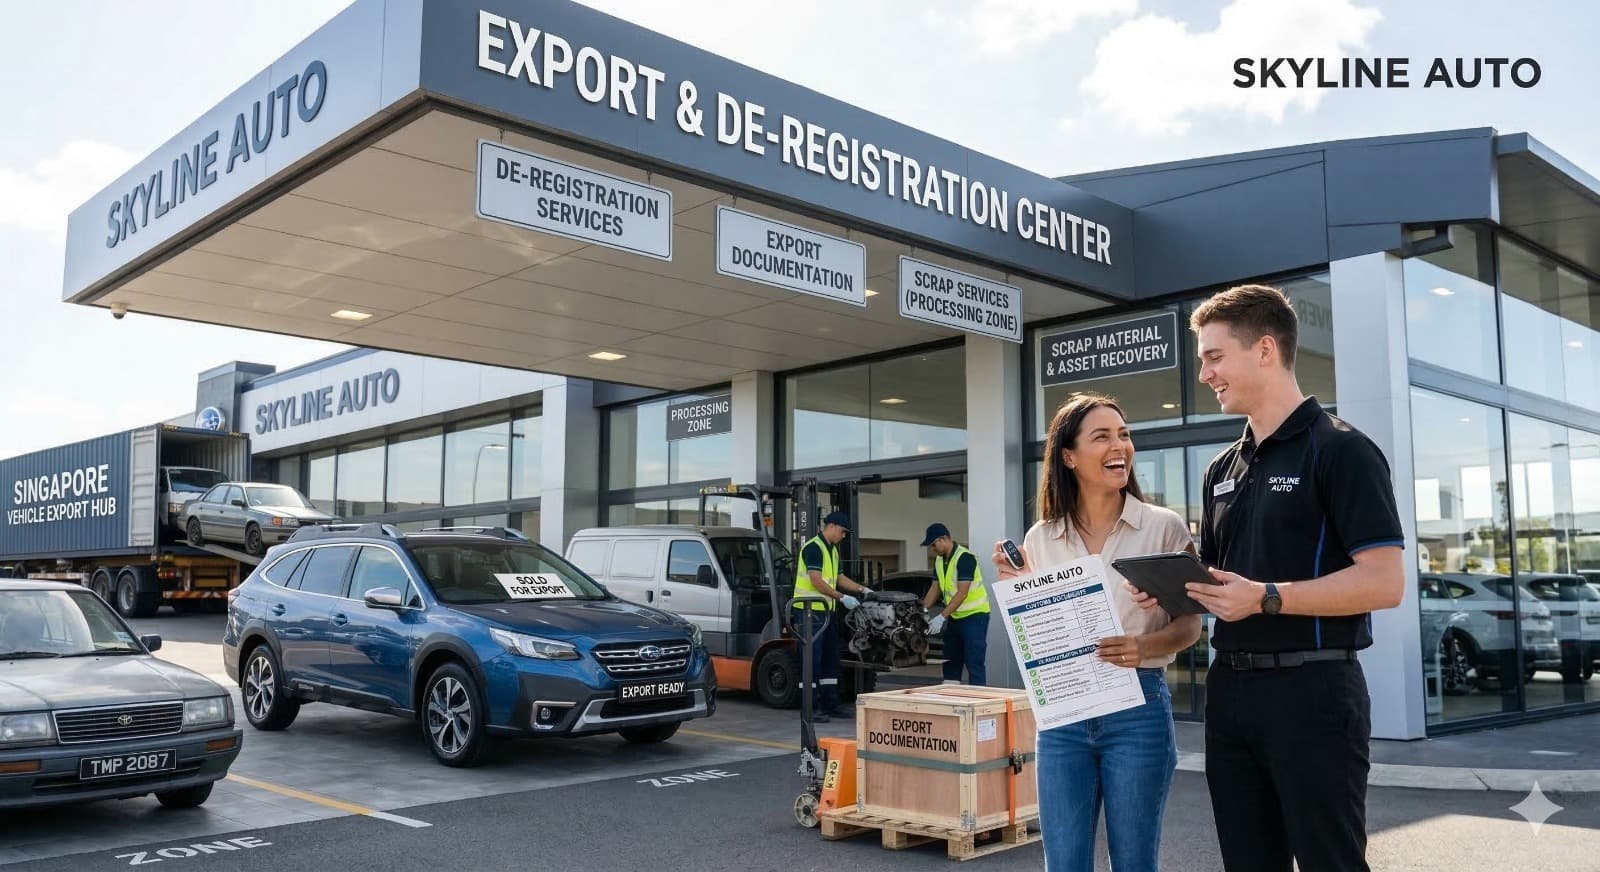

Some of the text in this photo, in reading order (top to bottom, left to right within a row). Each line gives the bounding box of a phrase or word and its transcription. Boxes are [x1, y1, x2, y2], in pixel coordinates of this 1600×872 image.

[478, 9, 1112, 265] EXPORT & DE-REGISTRATION CENTER
[106, 60, 327, 248] SKYLINE AUTO
[496, 158, 659, 219] DE-REGISTRATION
[537, 197, 624, 236] SERVICES
[767, 230, 822, 260] EXPORT
[732, 246, 853, 292] DOCUMENTATION
[915, 271, 1009, 309] SCRAP SERVICES
[906, 289, 1018, 335] (PROCESSING ZONE)
[1051, 326, 1162, 357] SCRAP MATERIAL
[1046, 343, 1169, 376] & ASSET RECOVERY
[255, 368, 400, 435] SKYLINE AUTO
[671, 401, 729, 421] PROCESSING
[687, 418, 712, 432] ZONE
[14, 464, 109, 505] SINGAPORE
[1268, 477, 1300, 485] SKYLINE
[7, 497, 116, 525] VEHICLE EXPORT HUB
[510, 585, 567, 595] FOR EXPORT
[516, 576, 548, 585] SOLD
[1014, 575, 1054, 592] SKYLINE
[1057, 566, 1083, 581] AUTO
[622, 681, 685, 698] EXPORT READY
[892, 718, 933, 734] EXPORT
[869, 731, 957, 753] DOCUMENTATION
[91, 753, 169, 775] TMP 2087
[115, 836, 273, 865] ZONE
